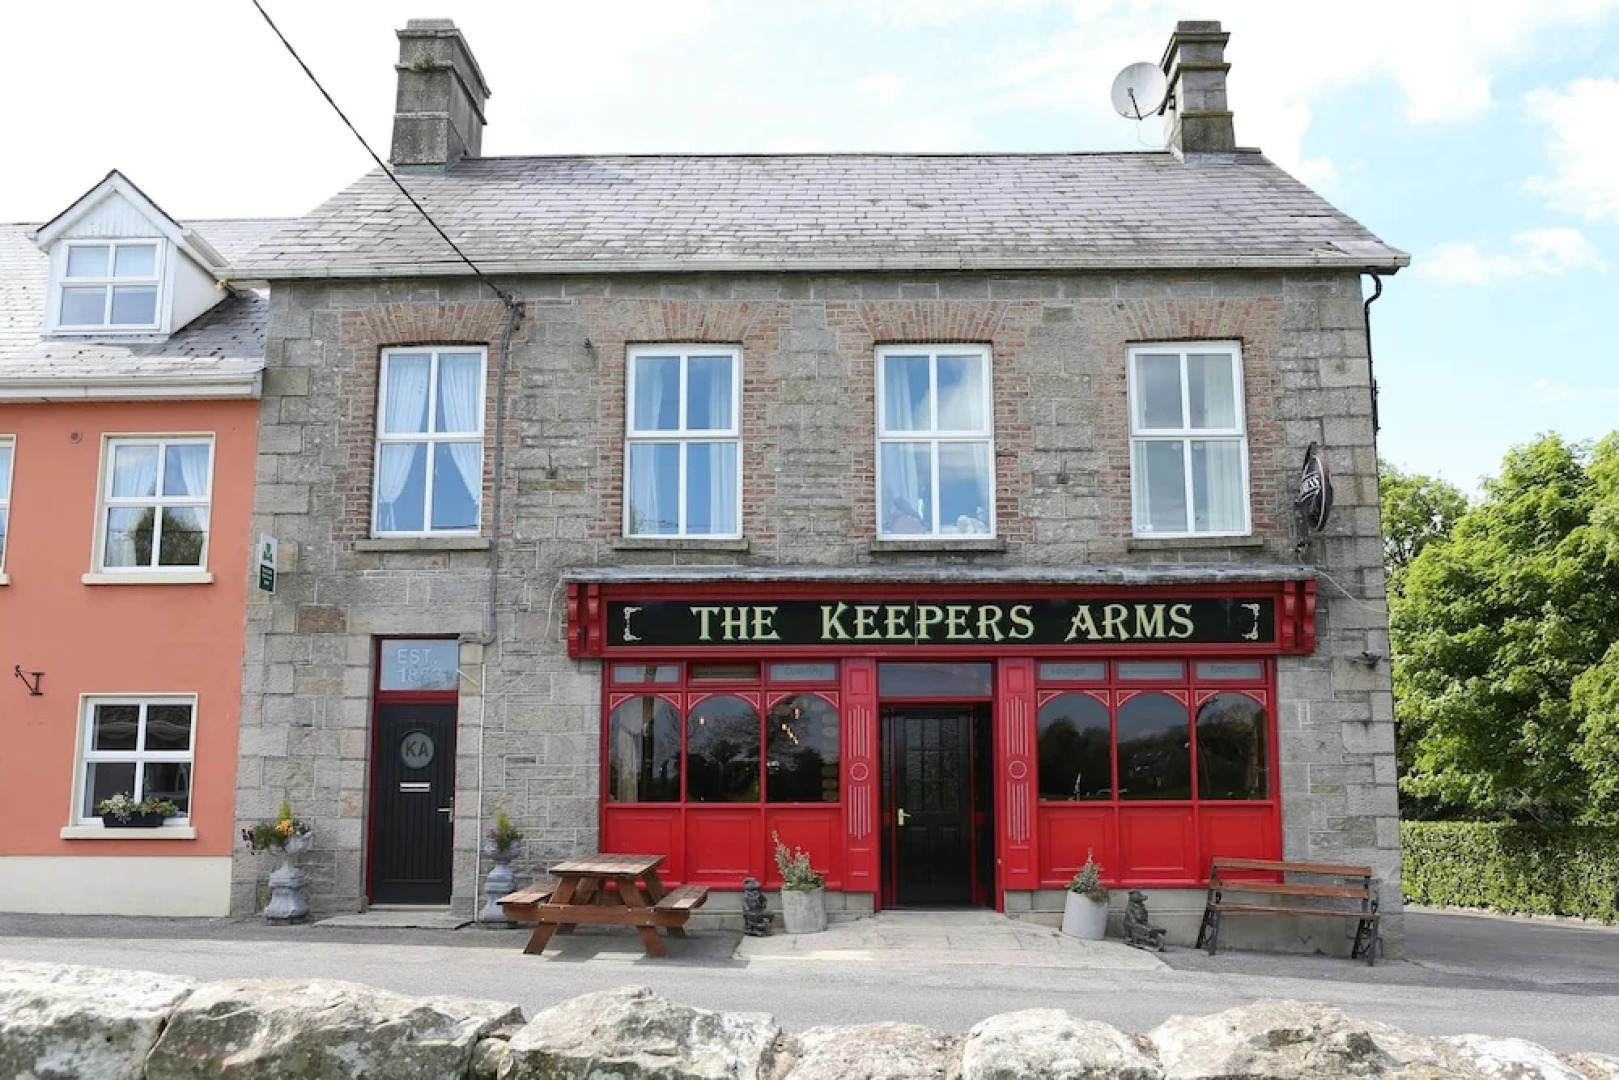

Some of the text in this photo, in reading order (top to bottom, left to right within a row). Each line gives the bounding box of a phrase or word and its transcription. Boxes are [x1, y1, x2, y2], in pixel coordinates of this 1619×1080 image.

[690, 601, 1194, 642] THE KEEPERS ARMS
[397, 648, 438, 665] EST.
[406, 740, 429, 757] KA
